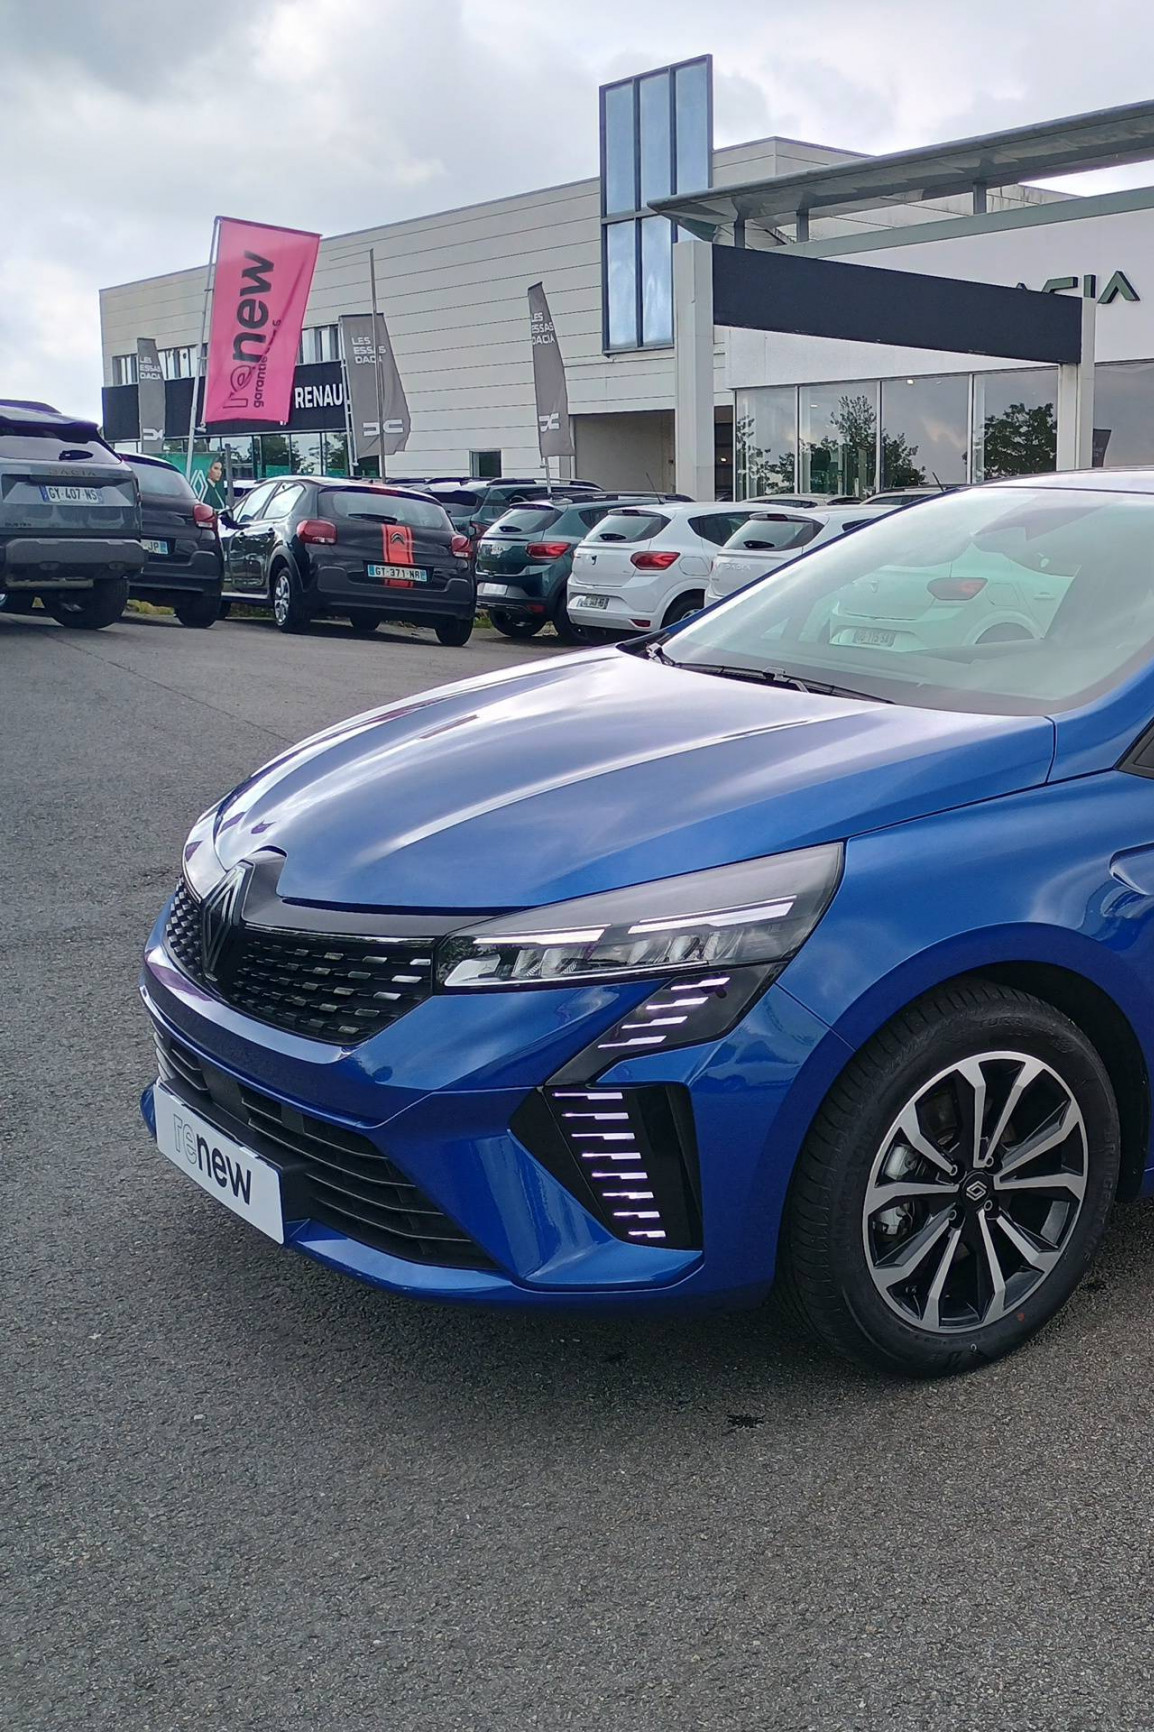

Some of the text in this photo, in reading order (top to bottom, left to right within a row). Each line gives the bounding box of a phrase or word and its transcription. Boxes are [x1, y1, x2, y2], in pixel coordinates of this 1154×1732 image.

[222, 250, 275, 409] renew
[351, 336, 371, 346] LES
[353, 345, 386, 355] ESSS
[253, 356, 269, 408] garantie
[294, 383, 344, 409] RENAU
[173, 1113, 252, 1206] renew
